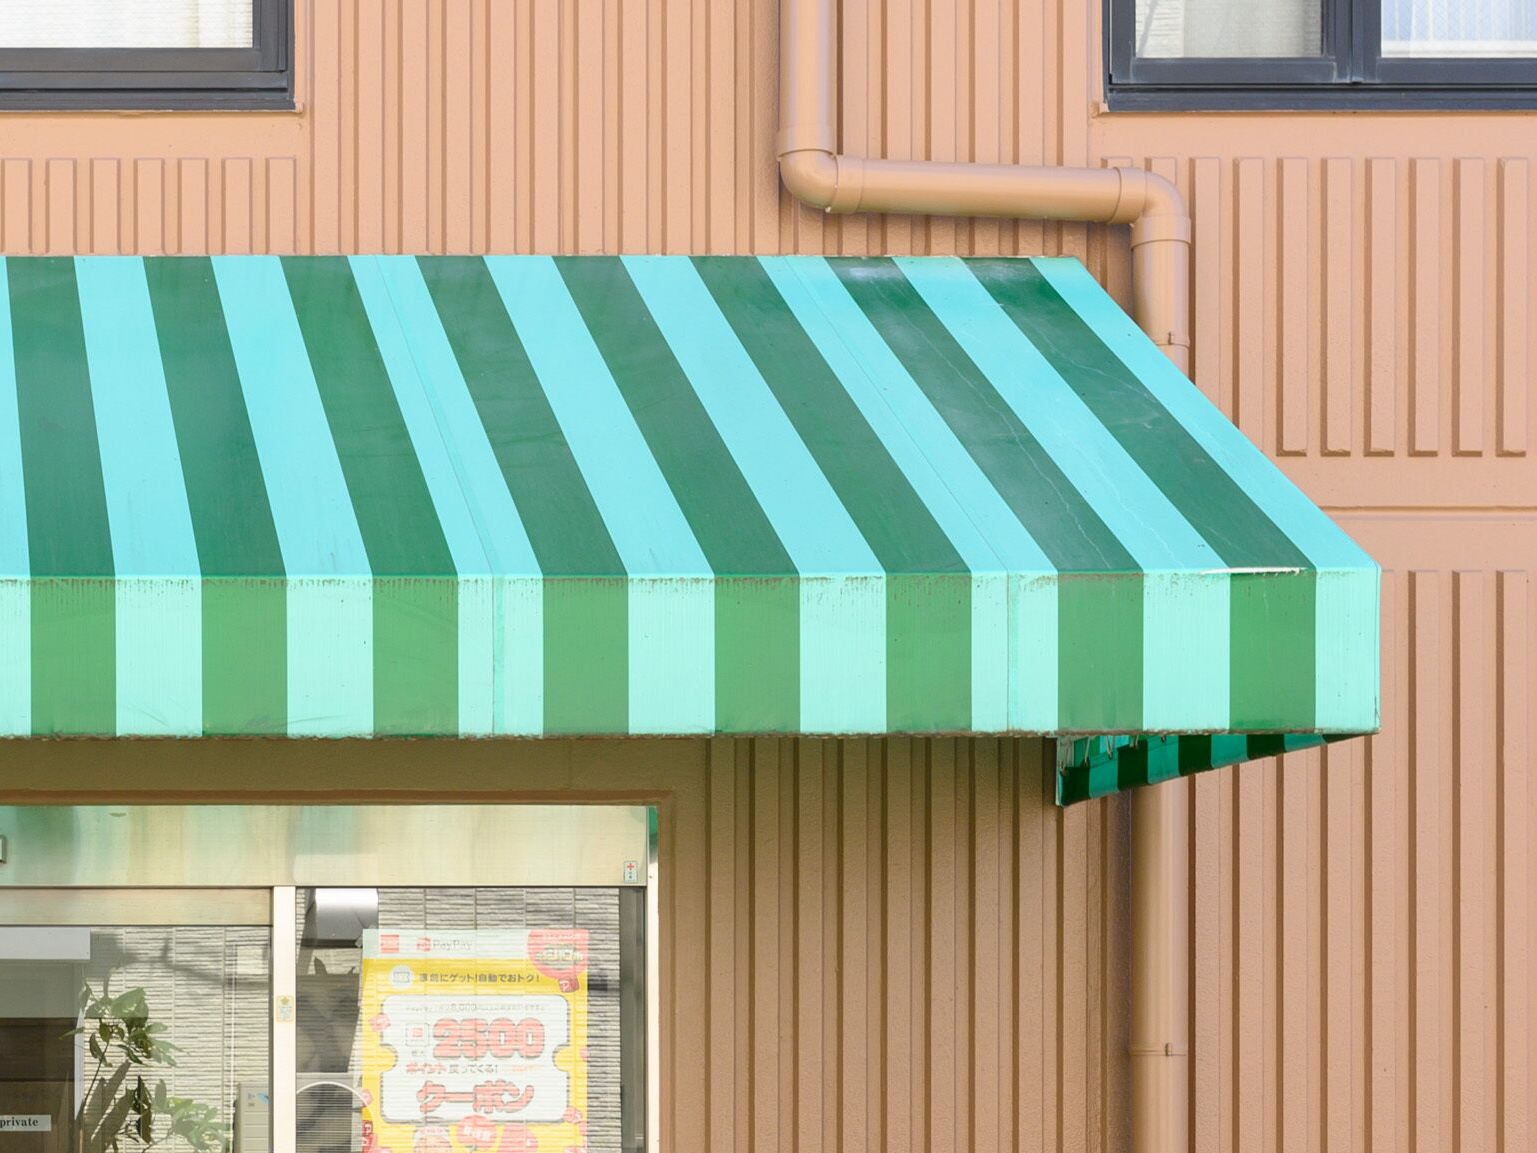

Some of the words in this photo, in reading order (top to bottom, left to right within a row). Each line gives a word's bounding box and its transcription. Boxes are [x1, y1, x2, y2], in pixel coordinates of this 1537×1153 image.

[432, 1016, 545, 1060] 2500
[416, 1079, 536, 1114] クーポン
[0, 1116, 39, 1129] private
